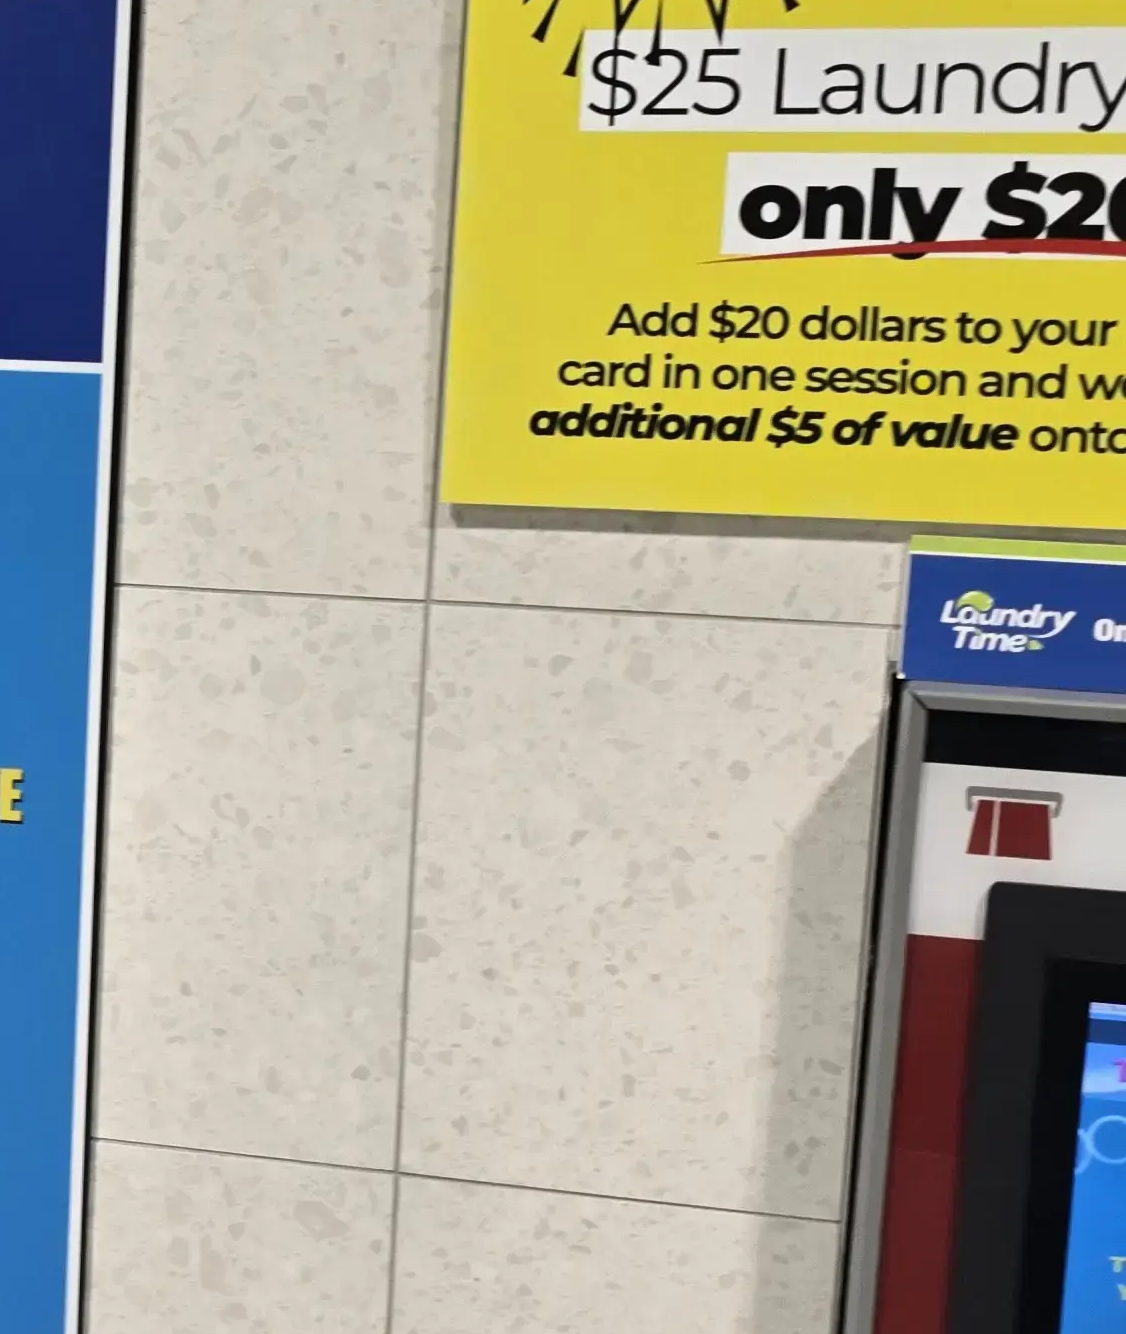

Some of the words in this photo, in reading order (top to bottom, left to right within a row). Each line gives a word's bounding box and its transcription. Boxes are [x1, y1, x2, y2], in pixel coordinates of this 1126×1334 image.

[587, 37, 743, 127] $25
[773, 40, 1126, 134] Laundry
[738, 166, 962, 260] only
[606, 301, 699, 338] Add
[709, 300, 791, 344] $20
[799, 304, 947, 344] dollars
[956, 310, 1003, 346] to
[1007, 316, 1119, 355] your
[557, 353, 652, 390] card
[664, 356, 701, 391] in
[711, 362, 796, 394] one
[805, 357, 967, 398] session
[978, 363, 1068, 400] and
[1078, 373, 1126, 402] w
[528, 402, 760, 444] additional
[765, 405, 826, 452] $5
[832, 410, 886, 448] of
[890, 412, 1020, 452] value
[940, 601, 1077, 639] Laundry
[952, 625, 1029, 654] Time
